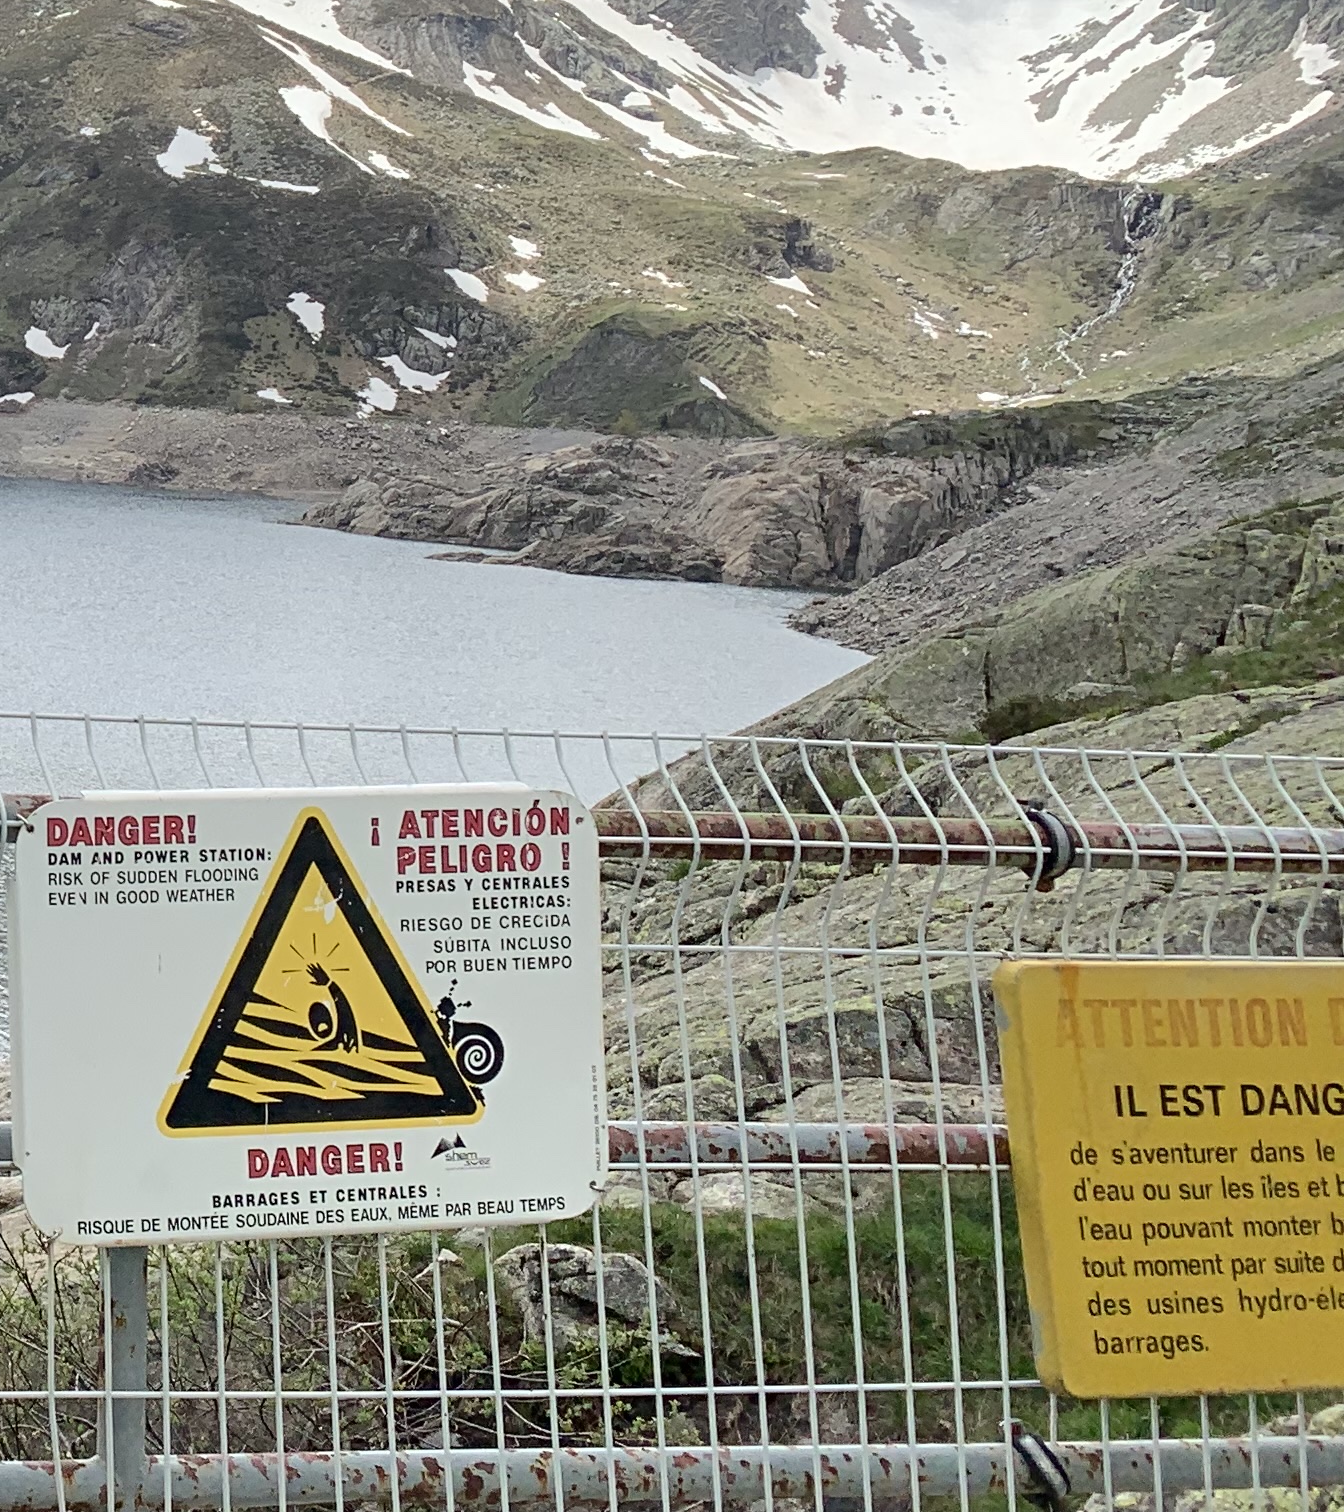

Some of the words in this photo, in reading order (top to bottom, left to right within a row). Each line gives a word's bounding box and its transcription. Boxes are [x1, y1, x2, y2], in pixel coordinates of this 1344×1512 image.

[46, 815, 196, 846] DANGER!
[398, 799, 570, 838] ATENCIÓN
[48, 852, 82, 866] DAM
[91, 851, 124, 865] AND
[134, 850, 189, 864] POWER
[200, 848, 272, 862] STATION:
[397, 842, 541, 874] PELIGRO
[561, 842, 570, 870] !
[49, 872, 83, 885] RISK
[91, 871, 110, 885] OF
[117, 870, 177, 884] SUDDEN
[185, 868, 259, 882] FLOODING
[396, 879, 456, 893] PRESAS
[464, 879, 473, 891] Y
[482, 876, 570, 890] CENTRALES
[49, 892, 86, 905] EVEN
[95, 892, 108, 904] IN
[117, 890, 159, 904] GOOD
[166, 889, 235, 902] WEATHER
[473, 895, 571, 910] ELECTRICAS:
[400, 917, 462, 932] RIESGO
[471, 917, 491, 929] DE
[499, 914, 571, 929] CRECIDA
[434, 936, 490, 953] SÚBITA
[501, 936, 571, 951] INCLUSO
[426, 960, 456, 973] POR
[464, 958, 506, 972] BUEN
[512, 956, 572, 970] TIEMPO
[1056, 998, 1308, 1048] ATTENTION
[1114, 1085, 1147, 1117] IL
[1159, 1084, 1225, 1117] EST
[1240, 1083, 1344, 1116] DANG
[247, 1142, 403, 1178] DANGER!
[1070, 1141, 1097, 1165] de
[1112, 1140, 1237, 1165] s'aventurer
[1251, 1139, 1305, 1162] dans
[1315, 1139, 1335, 1162] le
[212, 1191, 300, 1208] BARRAGES
[310, 1190, 326, 1204] ET
[336, 1185, 427, 1202] CENTRALES
[1074, 1177, 1134, 1202] d'eau
[1143, 1183, 1171, 1200] ou
[1179, 1182, 1213, 1200] sur
[1221, 1176, 1253, 1199] les
[1261, 1174, 1299, 1199] îles
[1308, 1176, 1330, 1198] et
[78, 1220, 134, 1235] RISQUE
[141, 1219, 160, 1232] DE
[168, 1212, 228, 1231] MONTÉE
[236, 1211, 309, 1228] SOUDAINE
[316, 1209, 344, 1223] DES
[352, 1207, 391, 1222] EAUX,
[446, 1202, 471, 1217] PAR
[478, 1200, 513, 1215] BEAU
[519, 1197, 565, 1212] TEMPS
[1079, 1216, 1132, 1240] l'eau
[1143, 1217, 1233, 1246] pouvant
[1243, 1215, 1321, 1237] monter
[1082, 1256, 1127, 1278] tout
[1134, 1254, 1224, 1277] moment
[1232, 1256, 1266, 1281] par
[1275, 1250, 1324, 1274] suite
[1088, 1291, 1131, 1317] des
[1148, 1291, 1224, 1314] usines
[1094, 1330, 1209, 1359] barrages.
